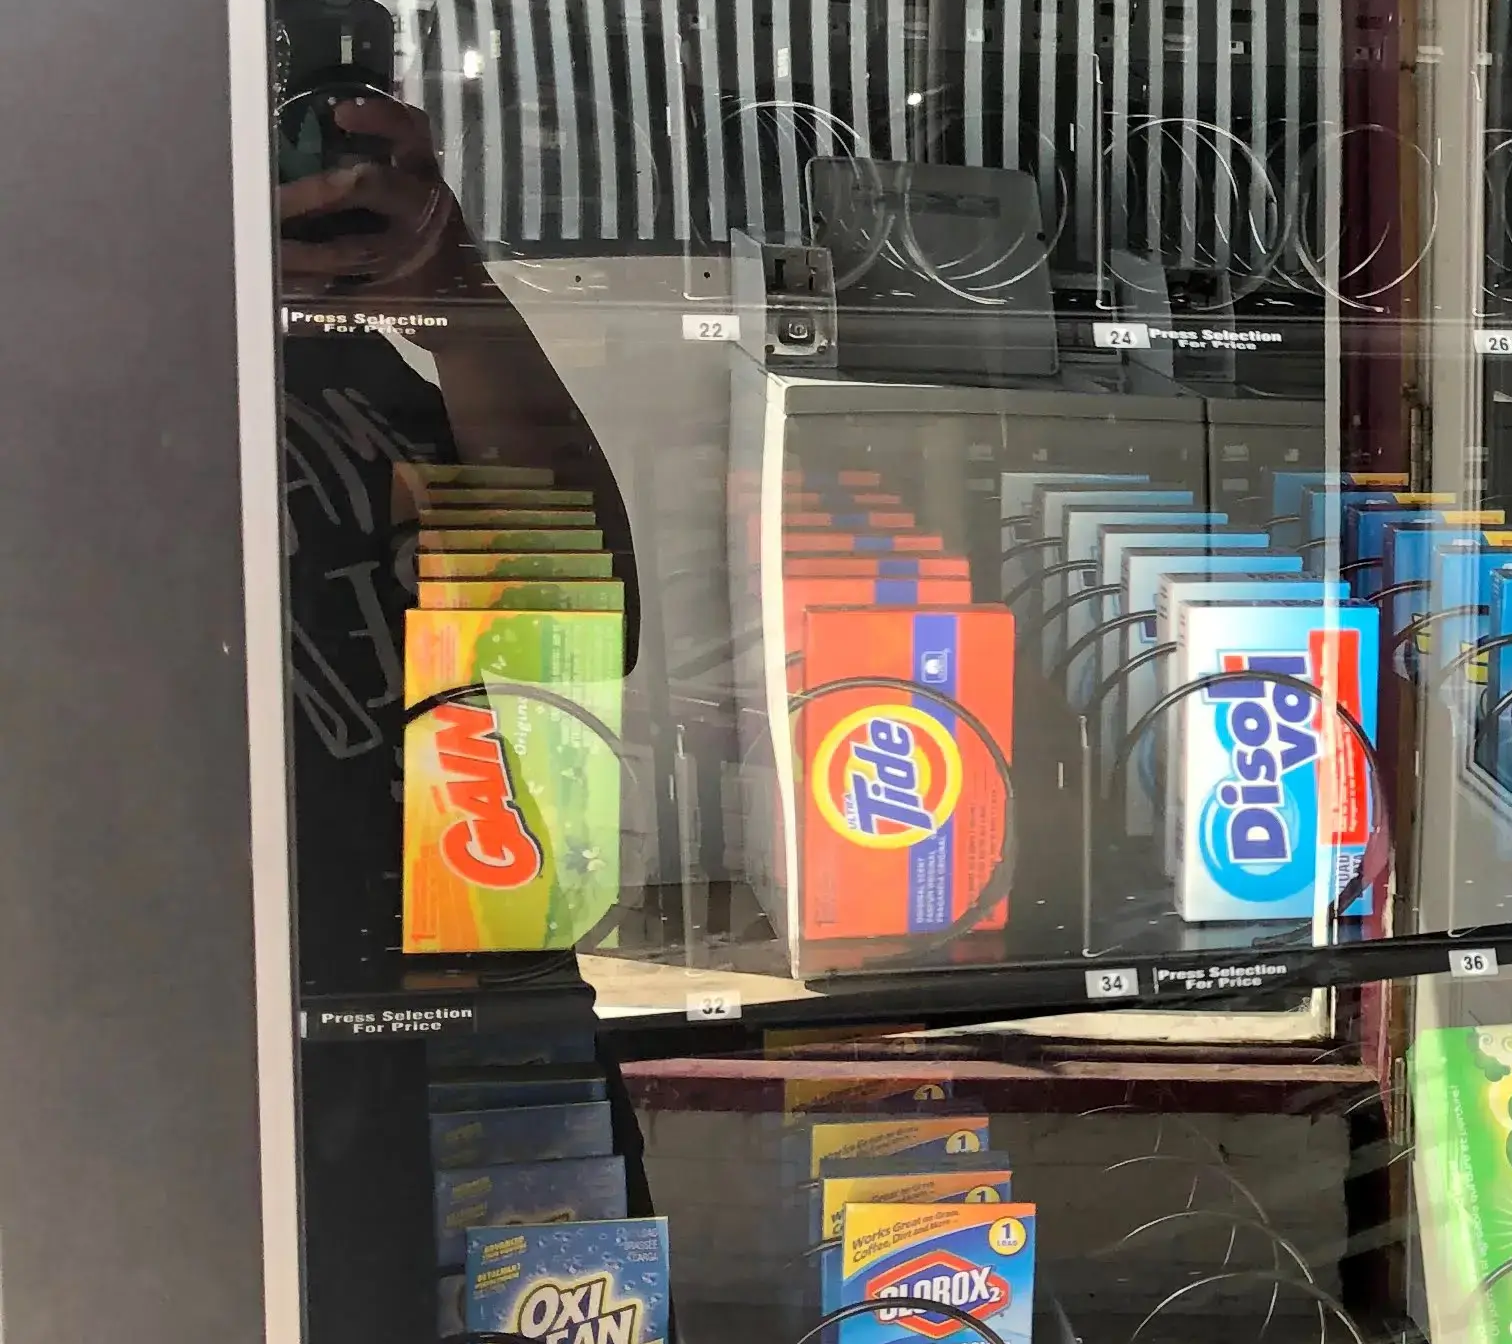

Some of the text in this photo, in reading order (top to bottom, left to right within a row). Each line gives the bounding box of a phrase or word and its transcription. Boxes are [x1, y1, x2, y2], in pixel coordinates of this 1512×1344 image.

[291, 311, 448, 327] Press Selection
[324, 323, 356, 333] For
[699, 322, 724, 339] 22
[1149, 327, 1282, 343] Press Selection
[1110, 330, 1132, 345] 24
[1177, 339, 1207, 349] For
[1488, 336, 1509, 353] 26
[854, 721, 932, 837] Tide
[433, 702, 542, 889] GAIN
[846, 792, 858, 831] ULTRA
[1158, 962, 1287, 981] Press Selection
[1464, 956, 1484, 971] 36
[1102, 975, 1124, 992] 34
[1185, 974, 1262, 989] For Price
[702, 996, 726, 1014] 32
[322, 1006, 473, 1025] Press Selection
[352, 1018, 442, 1034] For Price
[853, 1217, 921, 1250] Works Great
[1002, 1222, 1011, 1239] 1
[853, 1230, 911, 1263] Coffee, Dirt
[519, 1279, 606, 1338] OXI
